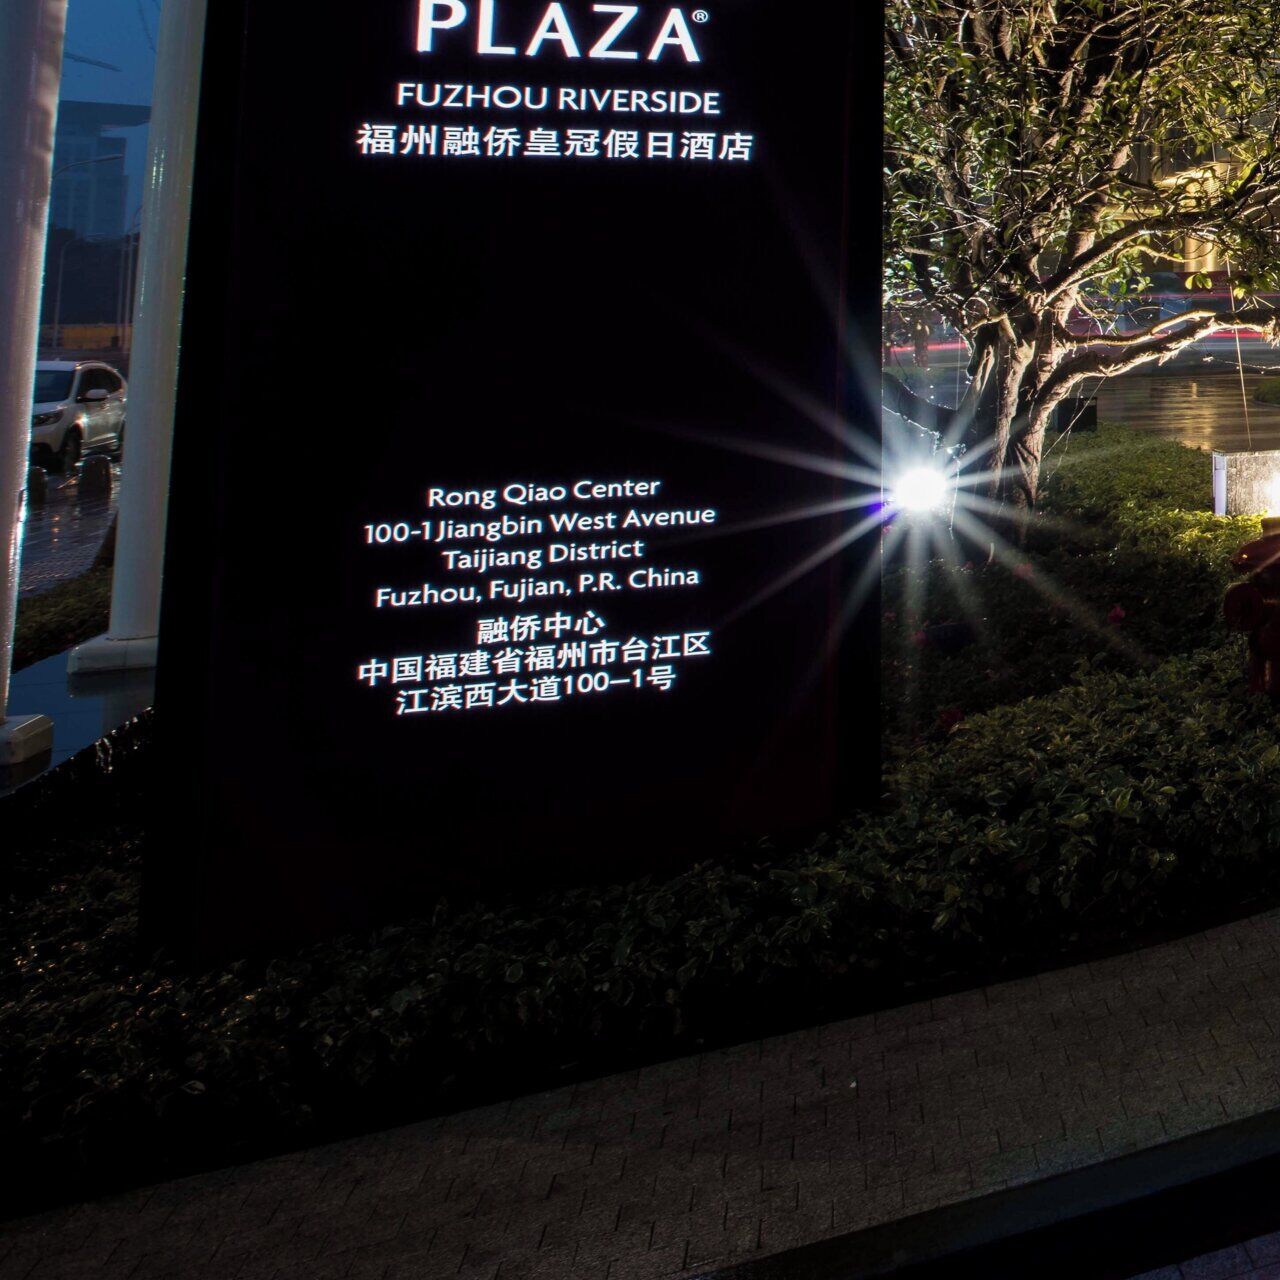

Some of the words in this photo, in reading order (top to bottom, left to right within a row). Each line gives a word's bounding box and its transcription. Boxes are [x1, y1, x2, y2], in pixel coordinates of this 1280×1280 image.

[397, 82, 549, 109] FUZHOU
[557, 87, 721, 114] RIVERSIDE
[355, 122, 754, 162] 福州融侨皇冠假日酒店
[428, 488, 496, 509] Rong
[503, 484, 567, 505] Qiao
[573, 480, 661, 499] Center
[364, 521, 432, 543] 100-1
[434, 515, 543, 542] Jiangbin
[549, 512, 617, 532] West
[622, 509, 716, 528] Avenue
[441, 549, 542, 573] Taijiang
[549, 540, 644, 562] District
[376, 584, 482, 607] Fuzhou,
[489, 578, 572, 602] Fujian,
[578, 573, 622, 592] P.R.
[628, 568, 699, 588] China
[476, 609, 606, 645] 融侨中心
[357, 630, 711, 687] 中国福建省福州市台江区
